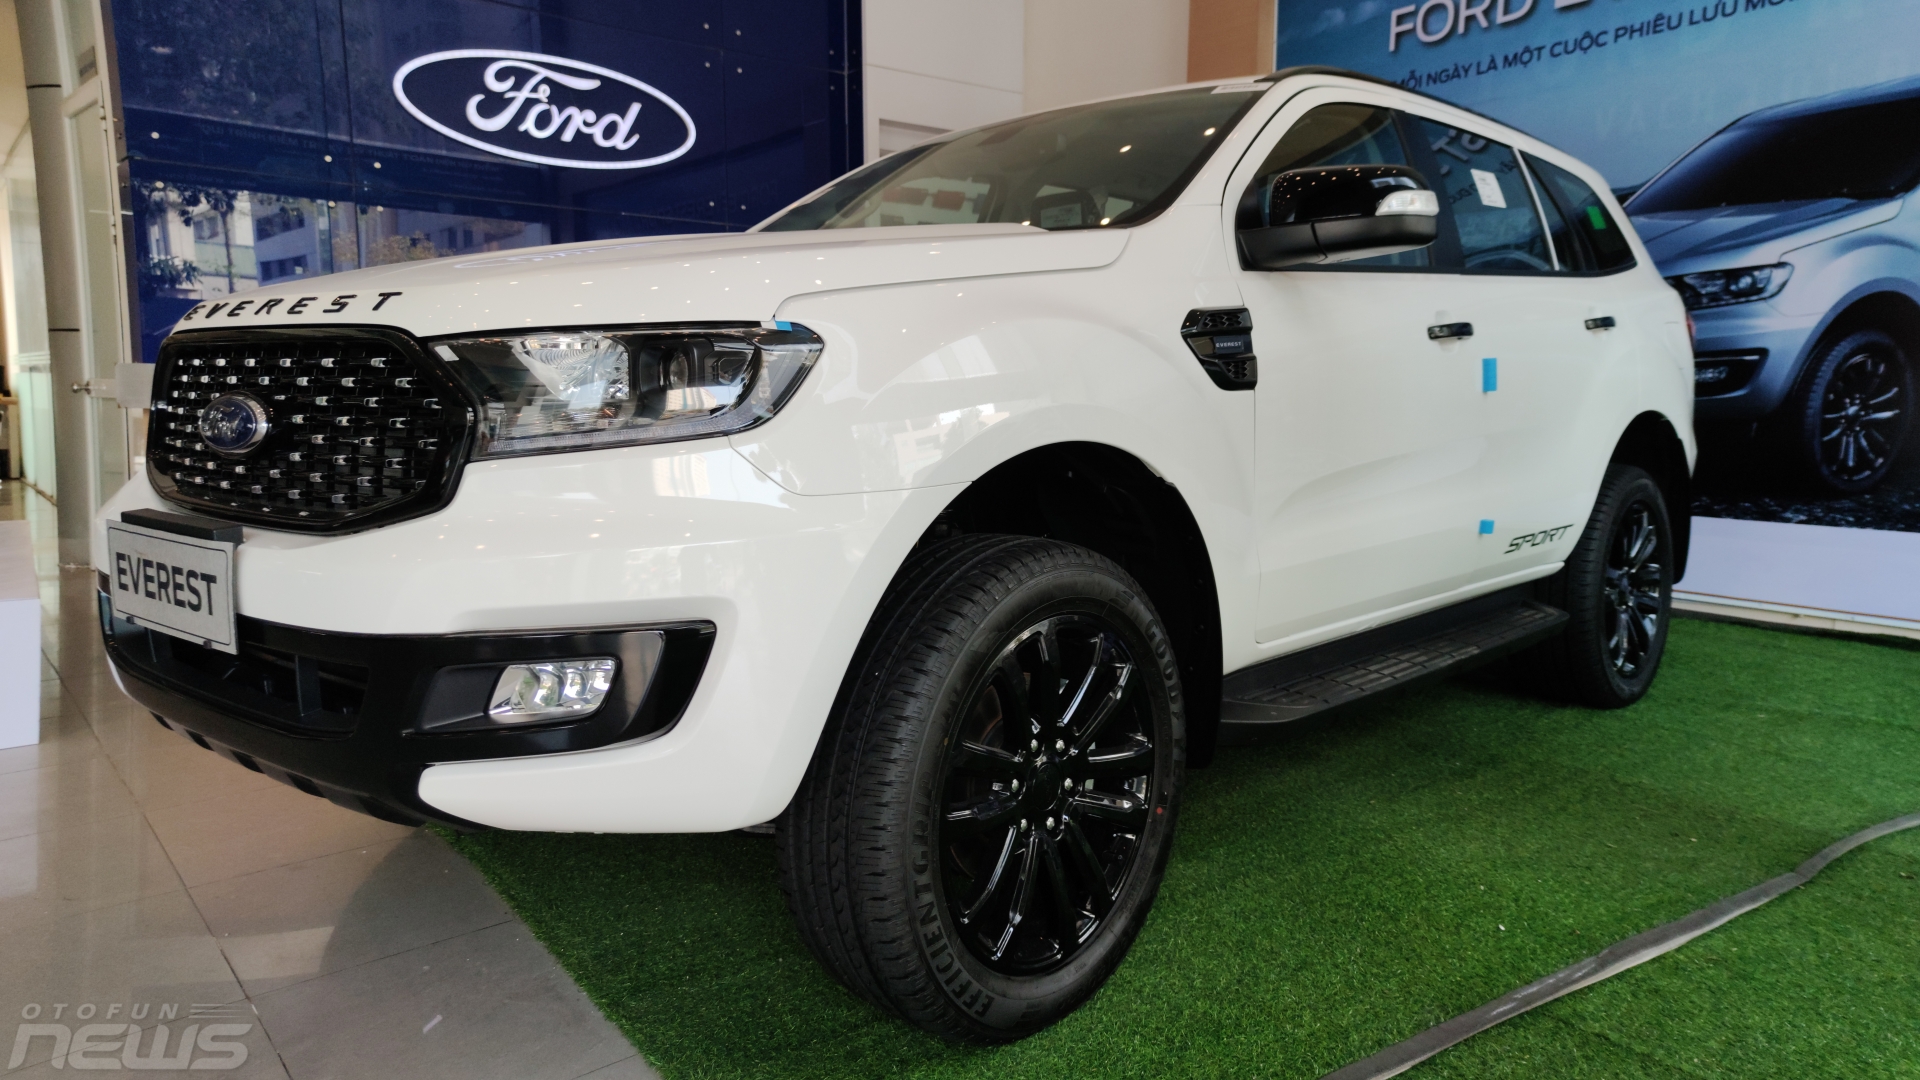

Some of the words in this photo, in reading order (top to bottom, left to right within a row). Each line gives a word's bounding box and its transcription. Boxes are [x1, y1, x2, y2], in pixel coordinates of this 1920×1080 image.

[1388, 0, 1534, 52] FORD
[1426, 62, 1473, 86] NGÀY
[1476, 54, 1498, 75] LÀ
[1502, 45, 1546, 68] MỘT
[1549, 30, 1609, 58] CUỘC
[1612, 12, 1683, 44] PHIÊU
[1688, 0, 1738, 25] LƯU
[465, 59, 642, 151] Ford
[184, 291, 403, 321] EVEREST
[1503, 523, 1574, 555] SPORT
[115, 551, 217, 616] EVEREST
